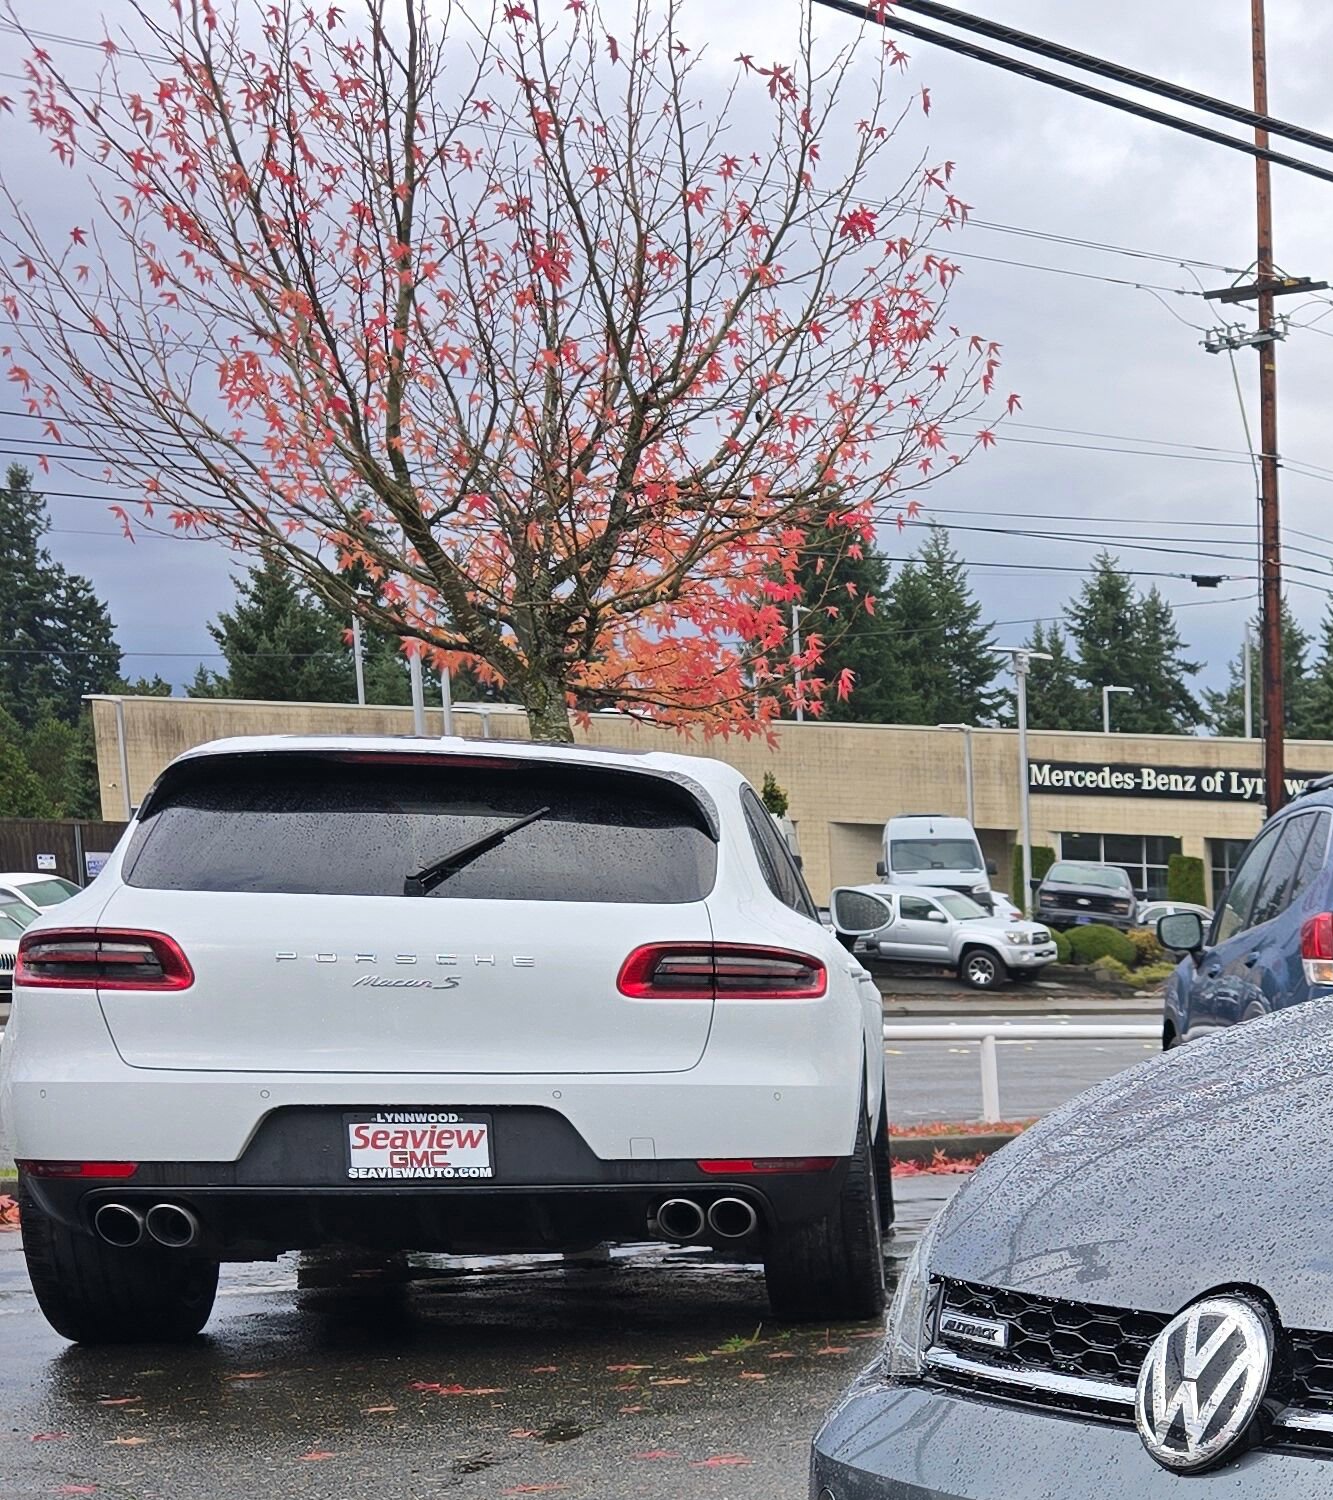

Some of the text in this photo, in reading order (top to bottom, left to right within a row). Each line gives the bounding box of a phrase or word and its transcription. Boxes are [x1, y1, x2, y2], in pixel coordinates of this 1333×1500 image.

[1029, 763, 1197, 792] Mercedes-Benz
[1201, 771, 1225, 793] of
[275, 951, 535, 968] PORSCHE
[352, 974, 462, 990] Macan S
[376, 1113, 459, 1123] LYNNWOOD
[351, 1125, 486, 1150] Seaview
[389, 1150, 451, 1168] GMC
[348, 1167, 493, 1179] SEAVIEWAUTO.COM
